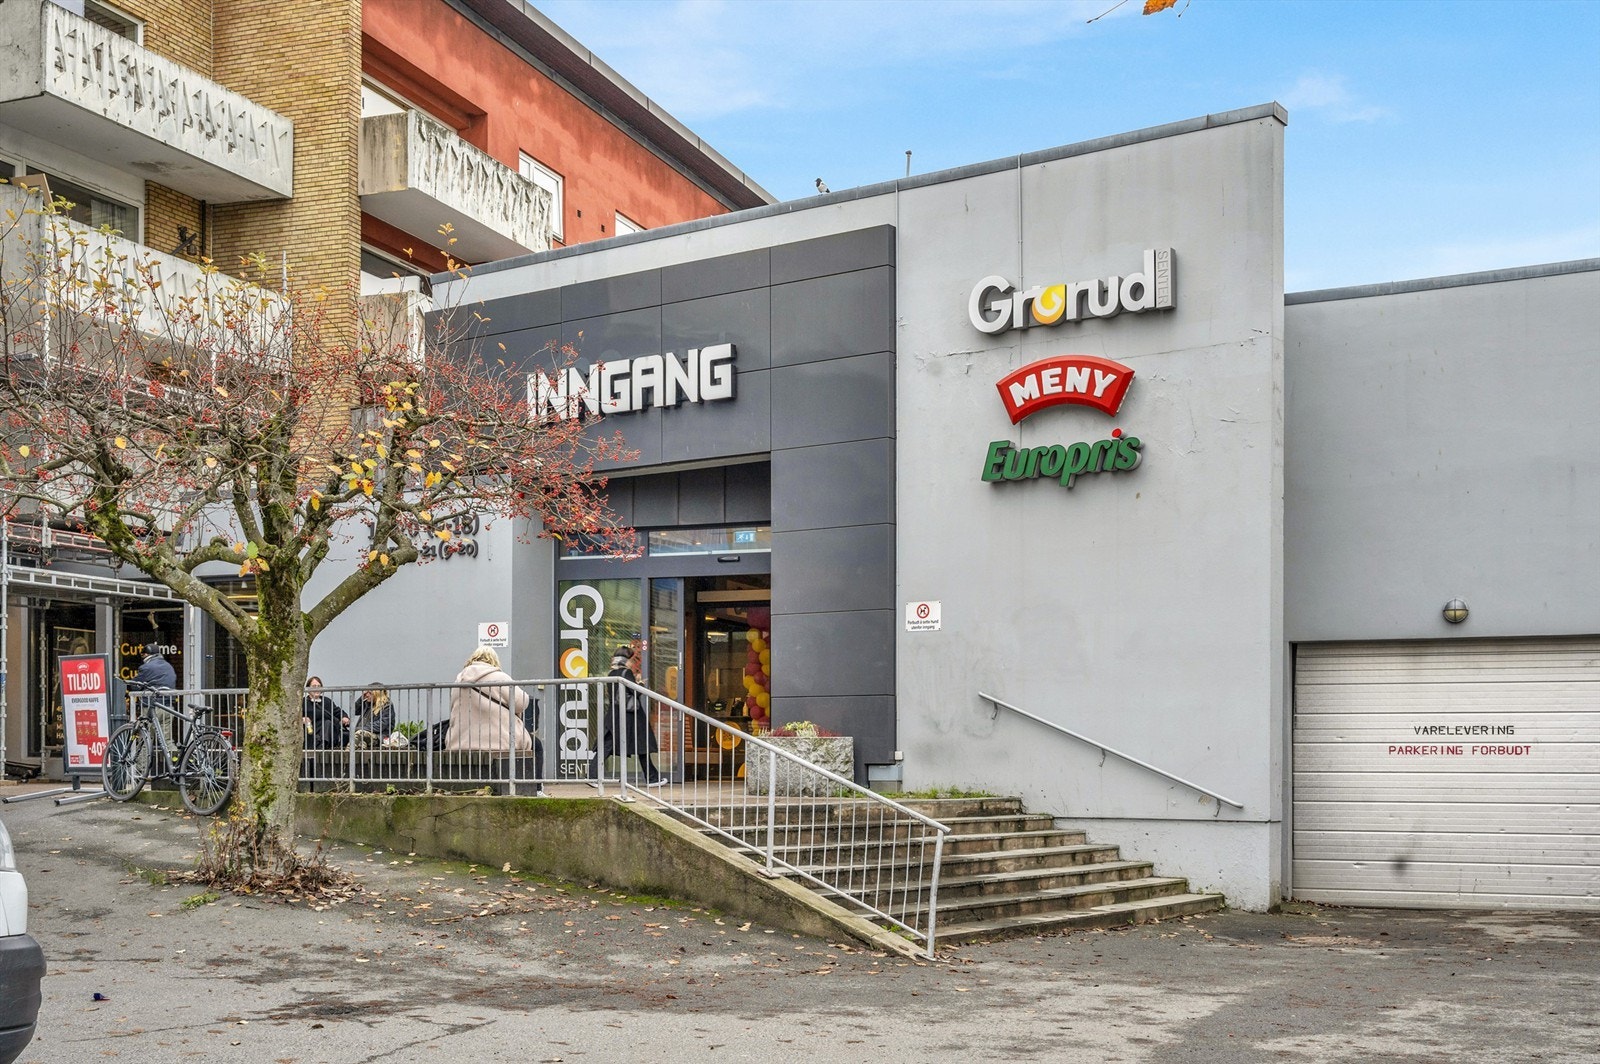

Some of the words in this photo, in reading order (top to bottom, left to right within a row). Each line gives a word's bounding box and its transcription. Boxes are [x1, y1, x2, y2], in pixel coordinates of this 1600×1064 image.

[1157, 250, 1169, 305] SENTER
[969, 249, 1156, 333] Grorud
[526, 343, 733, 419] INNGANG
[1008, 366, 1117, 408] MENY
[981, 428, 1143, 487] Europris
[439, 540, 479, 560] (920)
[121, 642, 144, 656] Cut
[67, 672, 100, 691] TILBUD
[121, 667, 138, 679] Cu
[1414, 726, 1515, 736] VARELEVERING
[1388, 746, 1464, 756] PARKERING
[1472, 746, 1531, 756] FORBUDT
[560, 763, 588, 774] SENT
